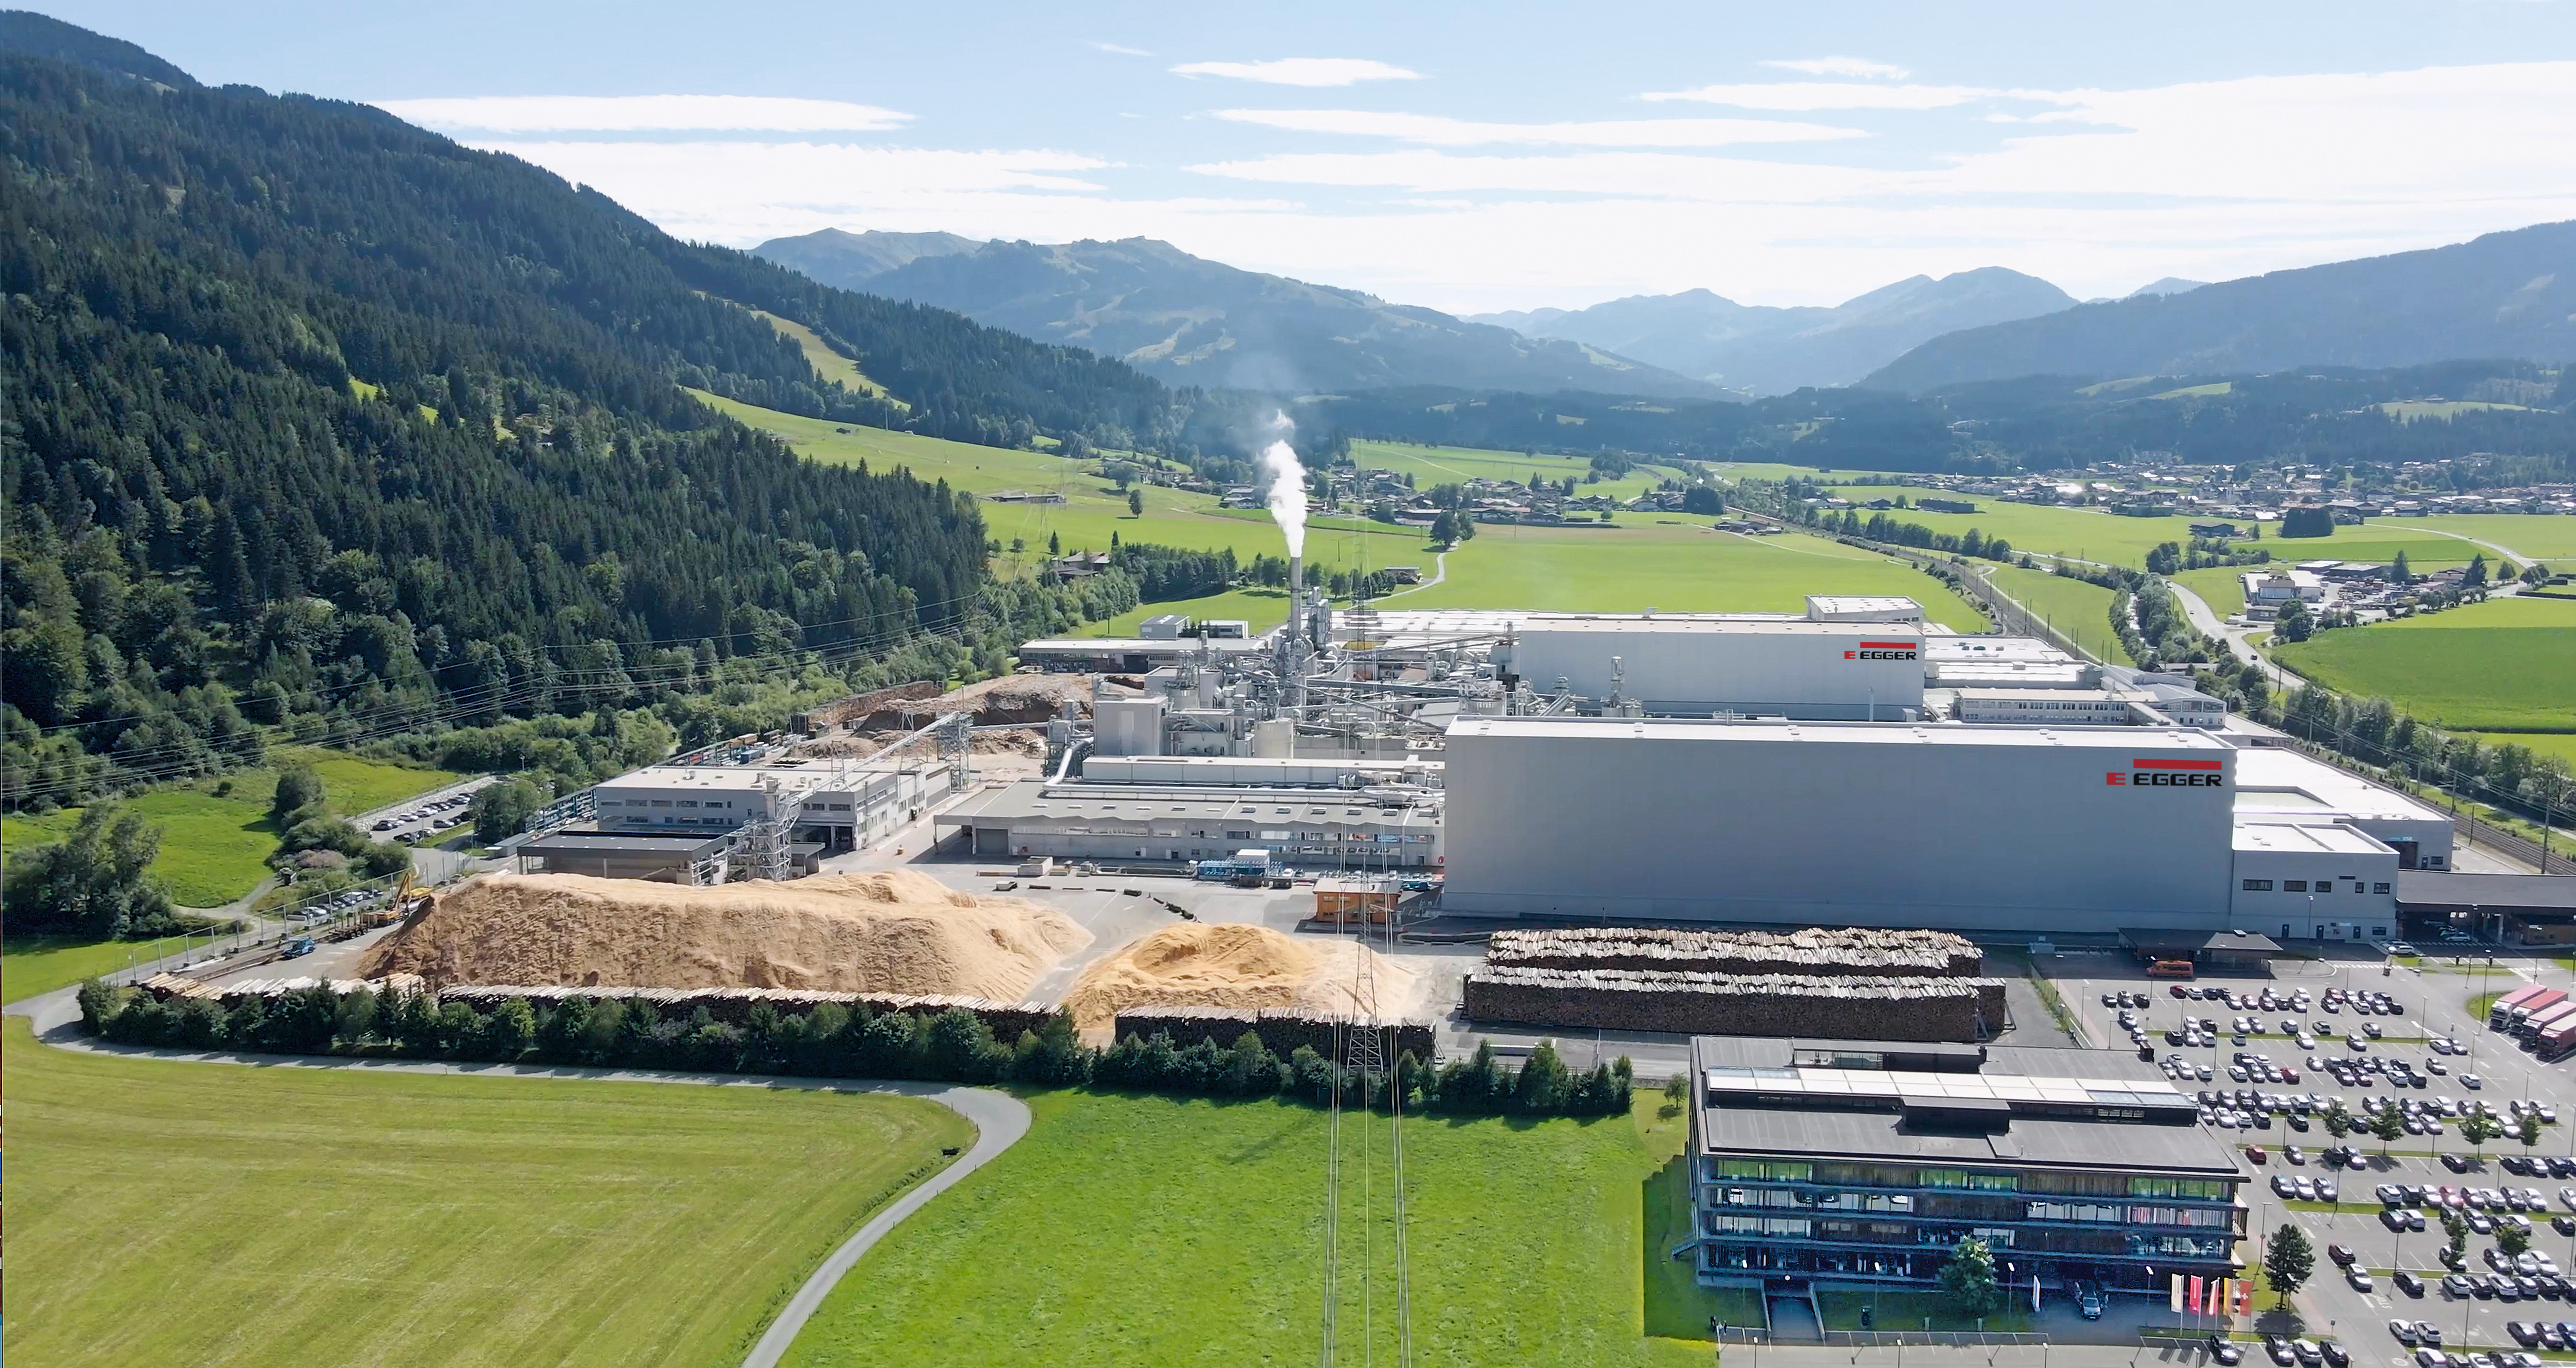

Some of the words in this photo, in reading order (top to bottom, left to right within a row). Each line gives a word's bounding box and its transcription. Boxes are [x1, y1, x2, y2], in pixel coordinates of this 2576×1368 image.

[1844, 651, 1856, 659] E
[1860, 651, 1917, 660] EGGER
[2106, 772, 2126, 785] E
[2133, 773, 2222, 786] EGGER
